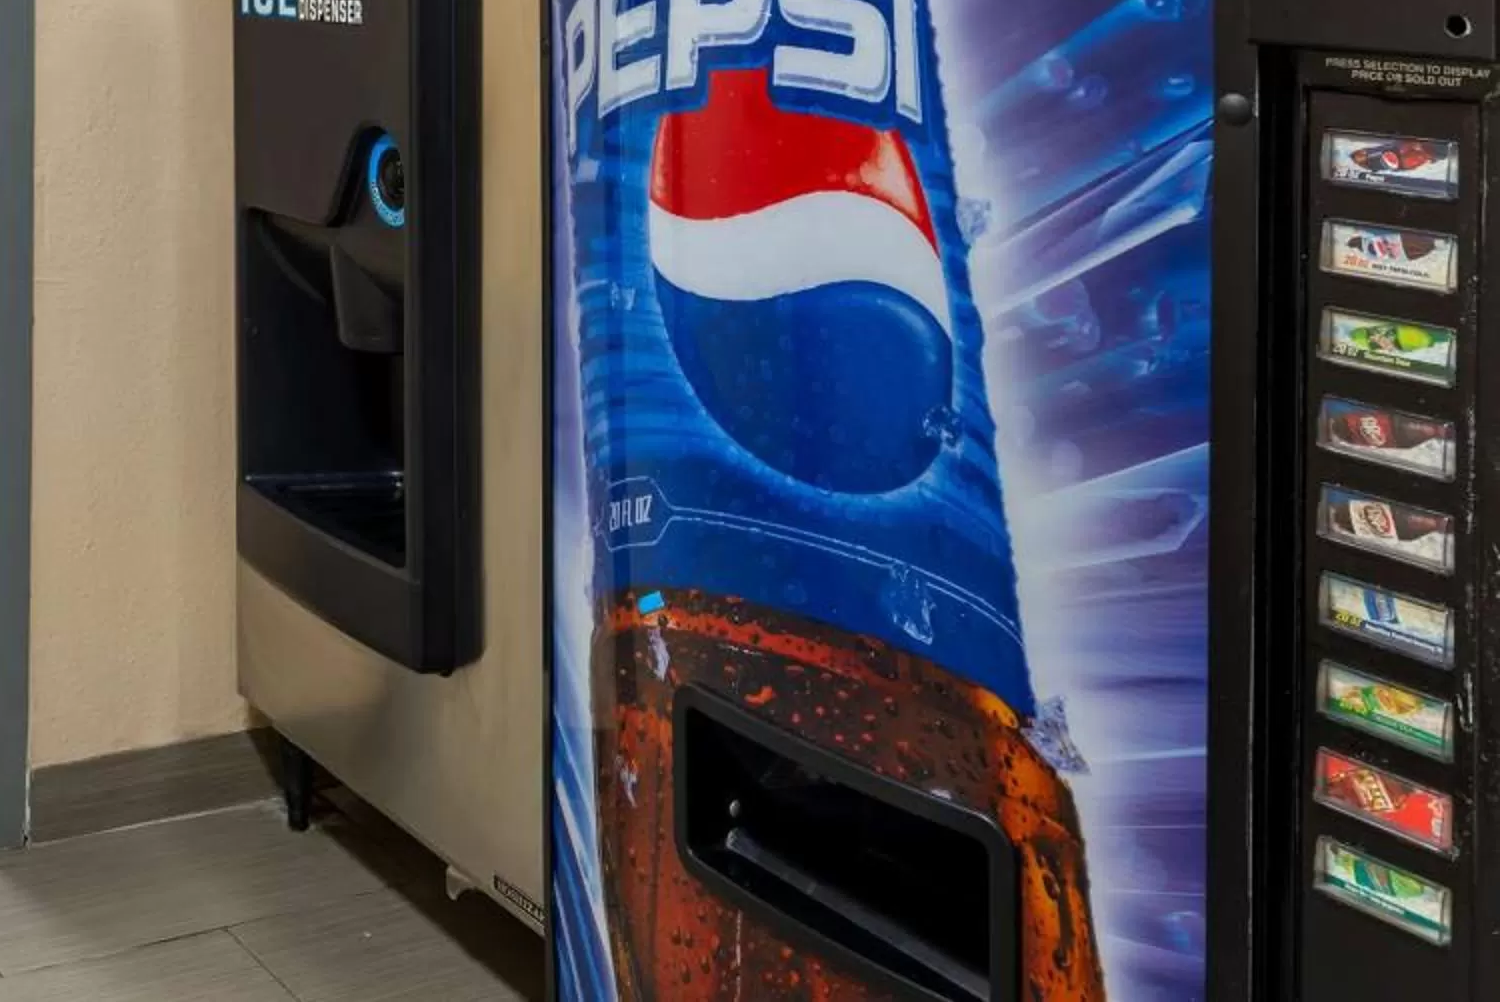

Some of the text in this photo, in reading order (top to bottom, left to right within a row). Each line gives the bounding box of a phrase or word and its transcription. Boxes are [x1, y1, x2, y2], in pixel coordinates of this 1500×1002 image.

[1325, 57, 1491, 79] PRESS SELECTION TO DISPLAY
[1351, 70, 1463, 87] PRICE OR SOLD OUT
[622, 498, 633, 527] FL
[635, 494, 652, 524] OZ
